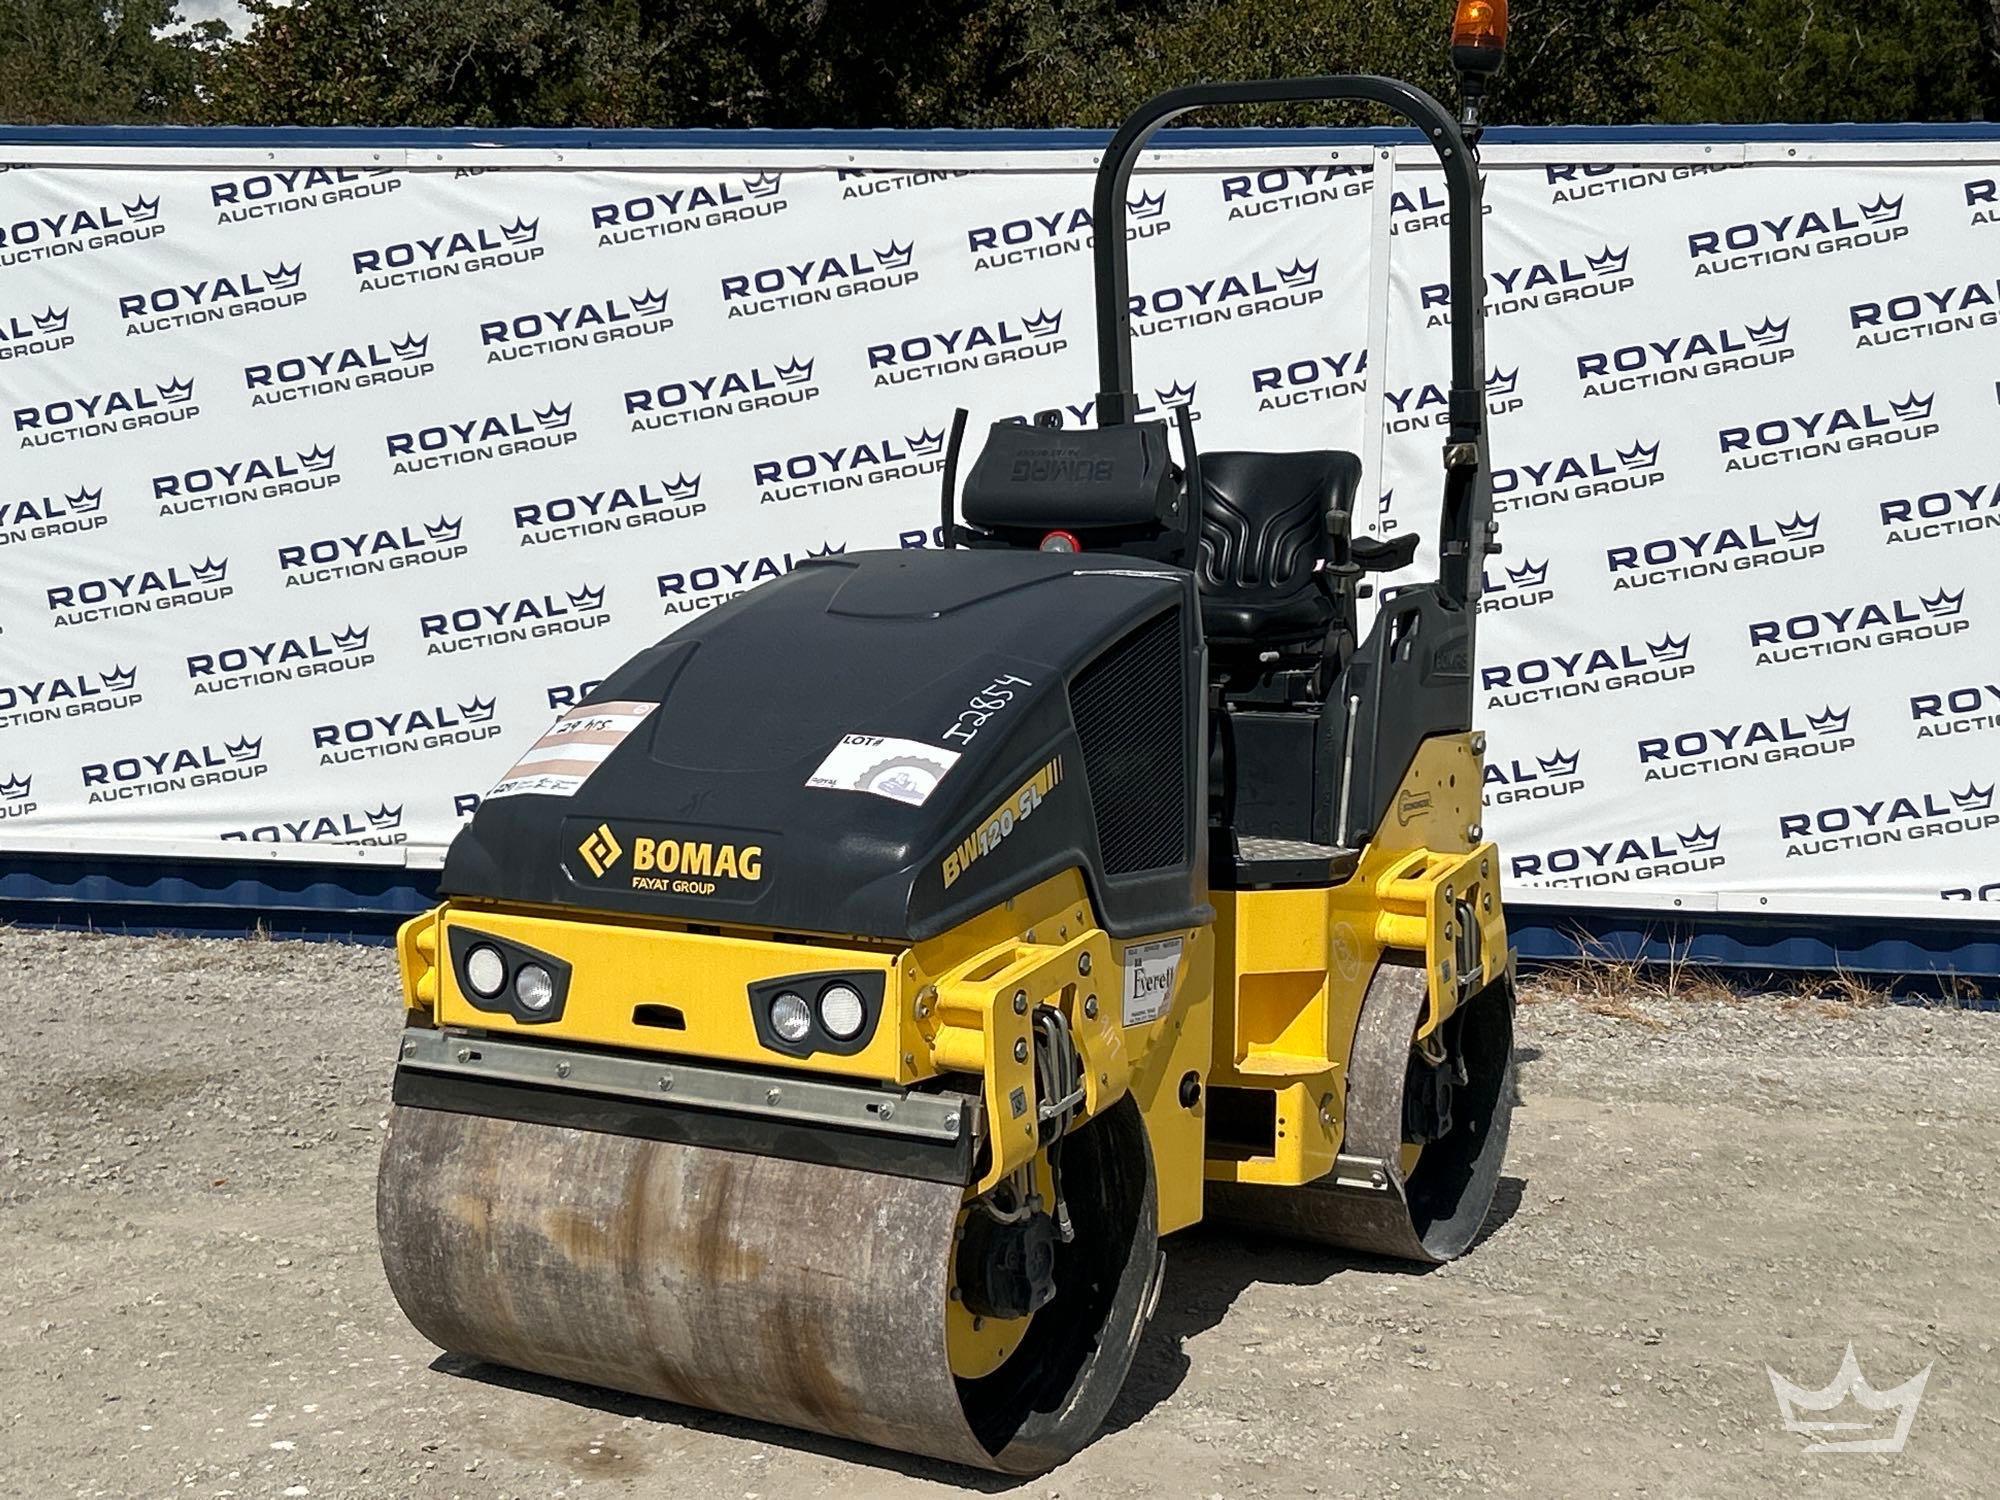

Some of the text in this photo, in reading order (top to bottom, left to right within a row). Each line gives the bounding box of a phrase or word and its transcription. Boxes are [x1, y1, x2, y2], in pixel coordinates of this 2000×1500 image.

[218, 179, 401, 224] AUCTION GROUP
[592, 183, 743, 229] ROYAL
[1229, 188, 1337, 220] AUCTION
[1553, 171, 1666, 204] AUCTION
[1, 225, 164, 265] UCTION GROUP
[599, 201, 787, 247] AUCTION GROUP
[968, 207, 1094, 253] ROYA
[1689, 208, 1859, 258] ROYAL
[353, 230, 501, 274] ROYAL
[360, 247, 543, 292] AUCTION GROUP
[975, 239, 1080, 271] AUCTION
[1695, 227, 1908, 277] AUCTION GROUP
[120, 274, 264, 318] ROYAL
[722, 254, 874, 300] ROYAL
[729, 272, 918, 318] AUCTION GROUP
[1420, 260, 1586, 310] RYAL
[1545, 278, 1634, 305] GROUP
[127, 292, 306, 336] AUCTION GROUP
[480, 300, 630, 345] ROYAL
[1238, 290, 1323, 316] GROUP
[1850, 280, 2000, 329] ROYA
[0, 336, 74, 359] GROUP
[488, 319, 673, 363] AUCTION GROUP
[868, 322, 1022, 369] ROYAL
[1856, 316, 1973, 348] AUCTION
[245, 345, 391, 389] ROYAL
[875, 340, 1067, 387] AUCTION GROUP
[1577, 330, 1745, 379] ROYAL
[1584, 349, 1794, 398] AUCTION GROUP
[252, 363, 434, 407] AUCTION GROUP
[625, 369, 775, 414] ROYAL
[1259, 380, 1366, 411] AUCTION
[14, 388, 157, 431] ROYAL
[21, 407, 199, 448] AUCTION GROUP
[632, 388, 819, 432] AUCTION GROUP
[1719, 405, 1889, 453] ROYAL
[387, 413, 534, 457] ROYAL
[394, 432, 576, 474] AUCTION GROUP
[1726, 424, 1939, 472] AUCTION GROUP
[153, 456, 298, 499] ROYAL
[754, 440, 906, 485] ROYAL
[1491, 453, 1616, 494] OYAL
[160, 475, 340, 516] AUCTION GROUP
[514, 485, 663, 528] ROYAL
[761, 475, 862, 504] AUCTION
[1575, 473, 1664, 498] GROUP
[31, 516, 107, 538] GROUP
[521, 504, 706, 546] AUCTION GROUP
[1887, 516, 2000, 544] AUCTION
[279, 527, 425, 569] ROYAL
[286, 546, 467, 587] AUCTION GROUP
[1607, 525, 1776, 571] ROYAL
[1614, 545, 1824, 590] AUCTION GROUP
[47, 568, 191, 610] ROYAL
[55, 587, 233, 627] AUCTION GROUP
[421, 596, 567, 638] ROYAL
[428, 614, 610, 655] AUCTION GROUP
[1749, 601, 1920, 647] ROYAL
[187, 636, 332, 678] ROYAL
[1756, 620, 1969, 665] AUCTION GROUP
[195, 655, 374, 695] AUCTION GROUP
[1481, 646, 1647, 690] ROYAL
[1488, 666, 1694, 709] AUCTION GROUP
[0, 676, 100, 710] OYAL
[66, 695, 142, 716] GROUP
[313, 707, 459, 748] ROYAL
[320, 726, 501, 765] AUCTION GROUP
[842, 735, 884, 747] LOT#
[1638, 718, 1806, 763] ROYAL
[1917, 715, 2000, 738] AUCTI
[82, 746, 225, 786] ROYAL
[1645, 738, 1854, 781] AUCTION GROUP
[89, 765, 267, 803] AUCTION GROUP
[1497, 781, 1584, 804] GROUP
[1780, 794, 1950, 839] ROYAL
[1786, 815, 1999, 857] AUCTION GROUP
[633, 838, 762, 880] BOMAG
[1512, 836, 1677, 878] ROYAL
[1636, 856, 1725, 879] GROUP
[632, 876, 716, 895] FAYAT GROUP
